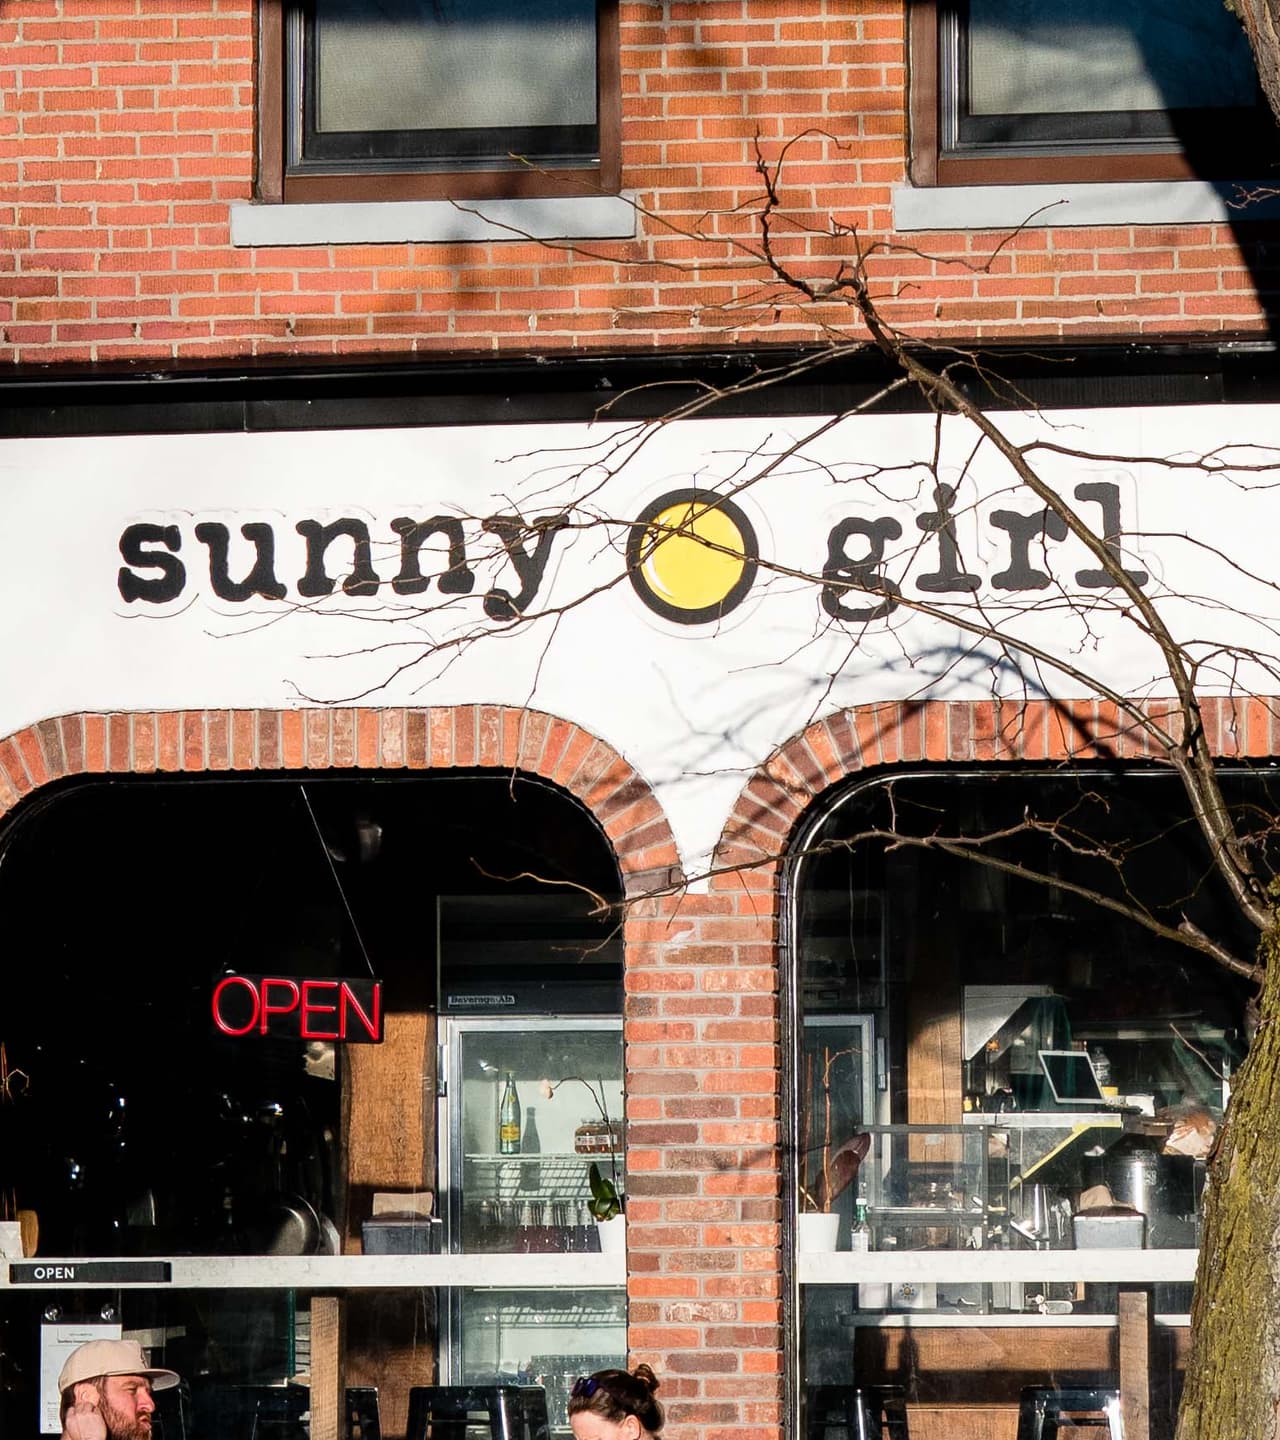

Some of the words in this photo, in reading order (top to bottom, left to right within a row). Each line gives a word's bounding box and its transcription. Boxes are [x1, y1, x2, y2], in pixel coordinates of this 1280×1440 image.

[117, 514, 570, 622] sunny
[821, 481, 1149, 623] girl
[211, 975, 381, 1041] OPEN
[33, 1267, 75, 1280] OPEN
